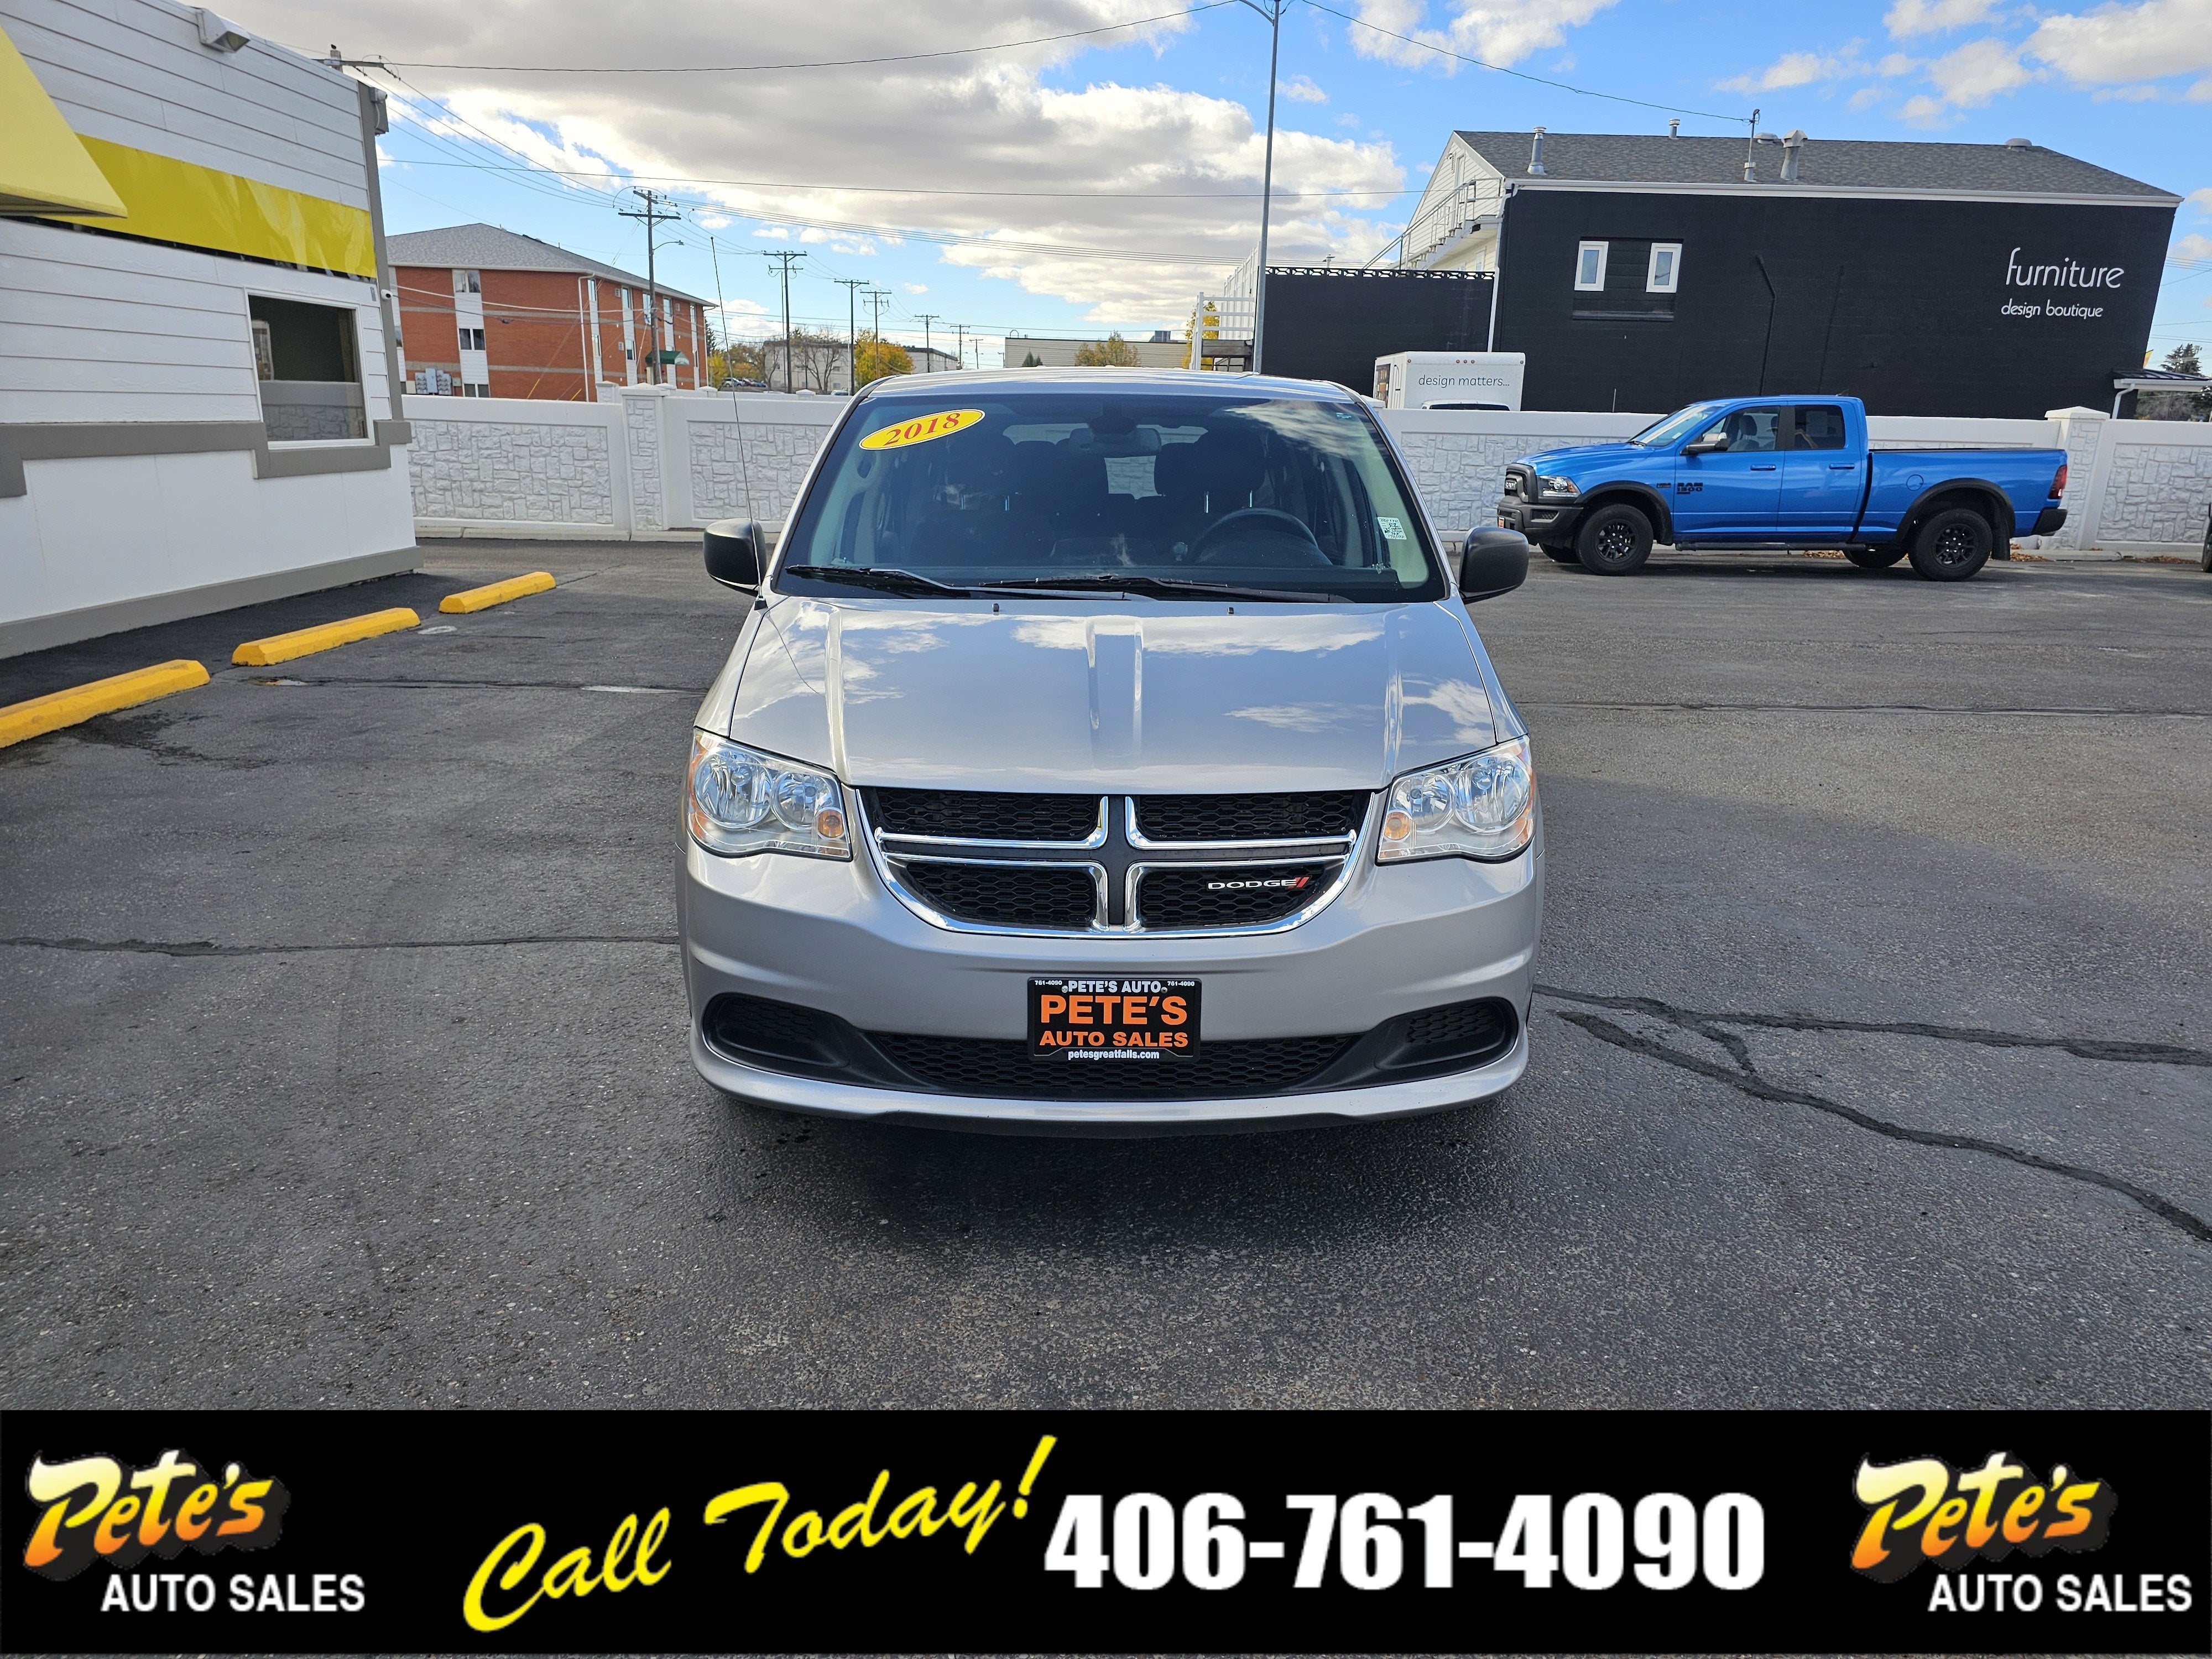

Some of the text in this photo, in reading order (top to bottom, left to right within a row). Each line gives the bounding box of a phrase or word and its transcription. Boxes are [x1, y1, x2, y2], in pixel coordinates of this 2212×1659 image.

[2006, 247, 2125, 288] furniture
[2001, 298, 2104, 320] design boutique
[1418, 374, 1510, 388] design matters...
[883, 413, 961, 446] 2018
[1208, 879, 1297, 890] DODGE
[1068, 980, 1161, 993] PETE'S AUTO
[1041, 994, 1187, 1025] PETE'S
[1040, 1030, 1188, 1047] AUTO SALES
[1068, 1049, 1160, 1061] petesgreatfalls.com
